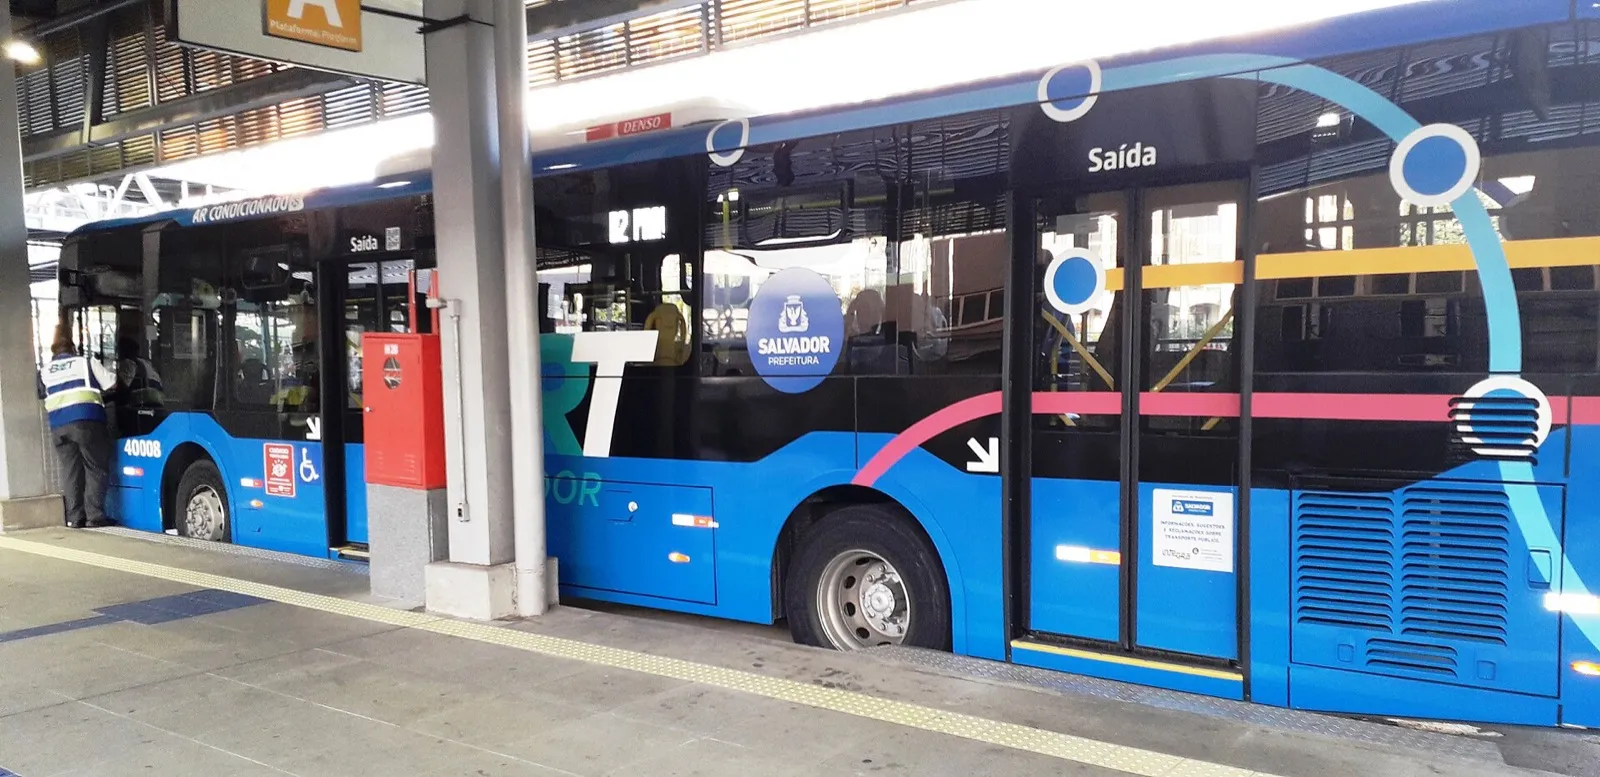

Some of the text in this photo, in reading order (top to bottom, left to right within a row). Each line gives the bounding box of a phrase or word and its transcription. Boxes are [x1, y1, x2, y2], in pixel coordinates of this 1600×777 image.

[623, 116, 661, 134] DENSO
[1088, 141, 1157, 173] Saída
[192, 195, 289, 224] AR CONDICIONADO
[350, 234, 379, 252] Saída
[758, 335, 831, 355] SALVADOR
[768, 355, 820, 366] PREFEITURA
[540, 330, 660, 459] RT
[123, 438, 162, 459] 40008
